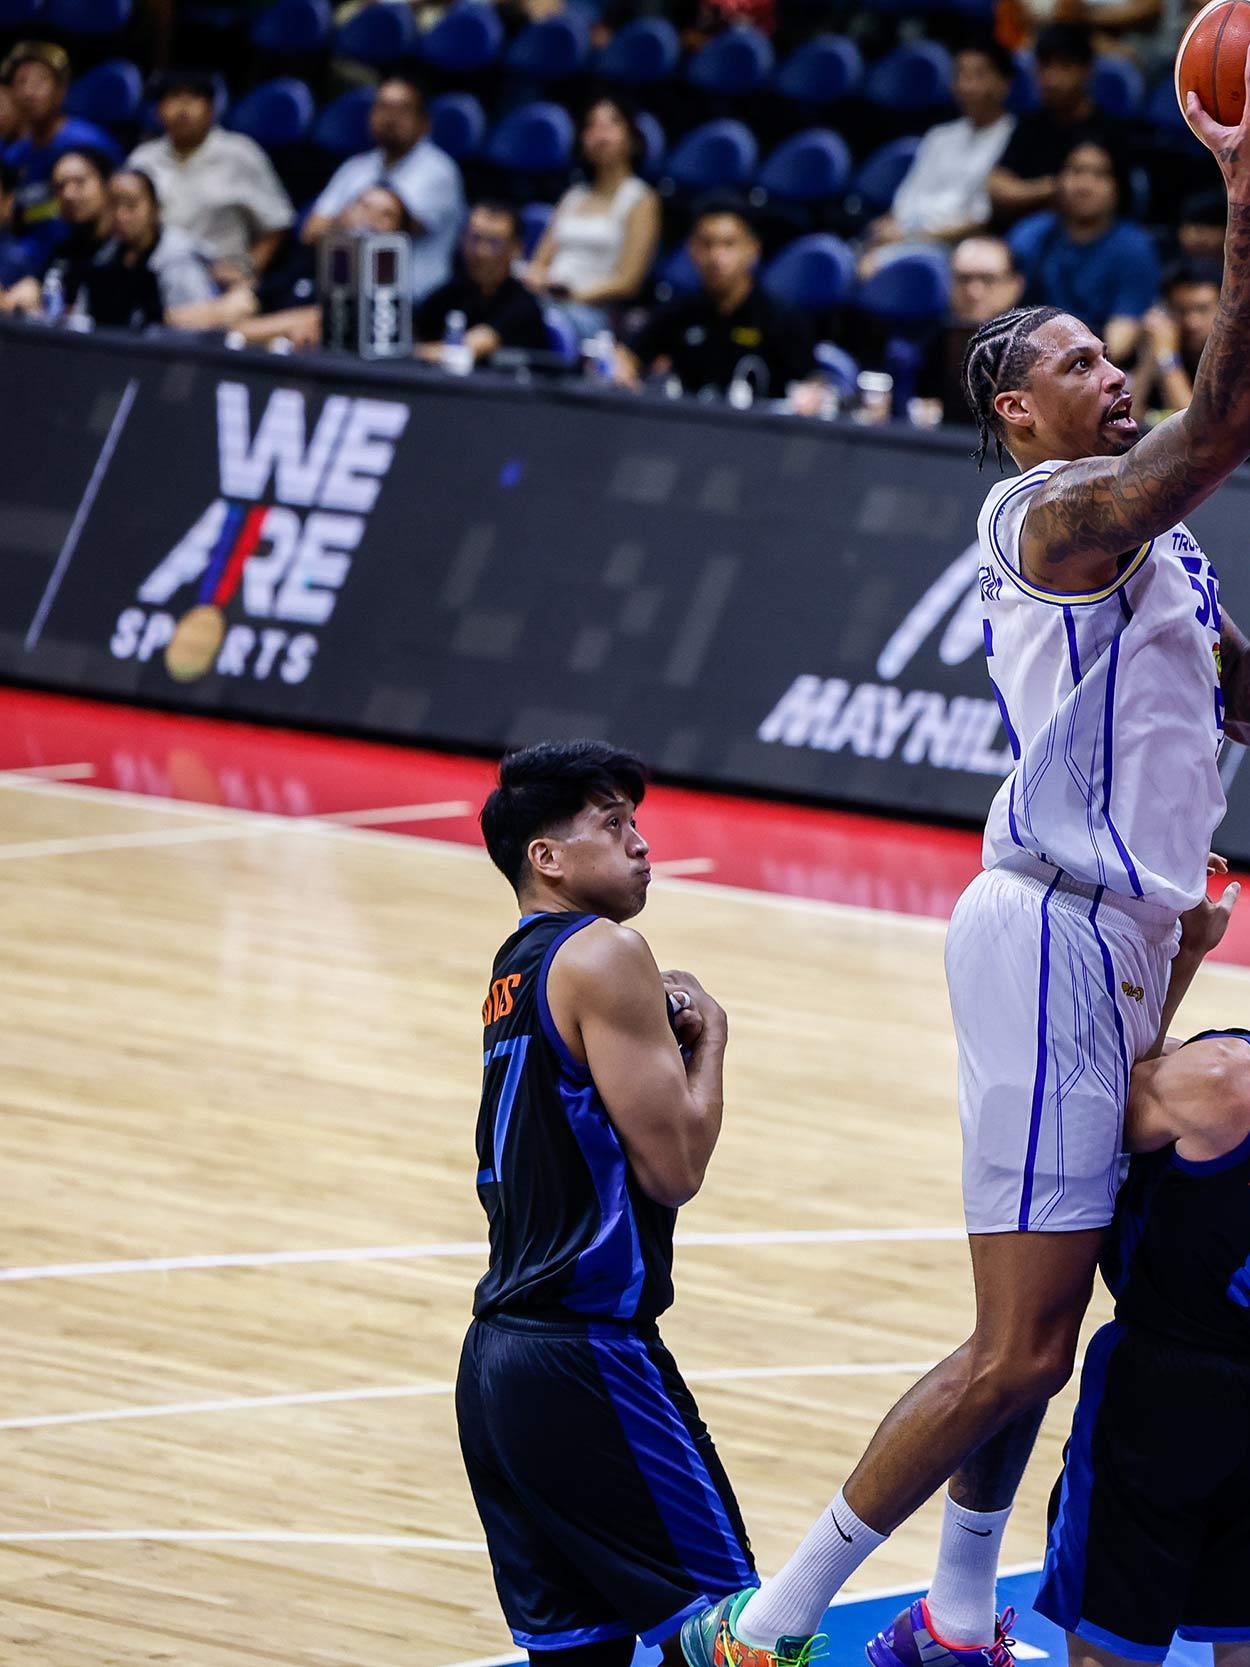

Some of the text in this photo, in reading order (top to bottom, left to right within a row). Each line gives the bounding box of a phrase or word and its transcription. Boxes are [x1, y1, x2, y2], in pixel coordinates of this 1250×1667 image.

[216, 380, 410, 514] WE
[138, 498, 366, 626] ARE
[758, 673, 1014, 776] MAYNIL
[476, 1035, 532, 1185] 7
